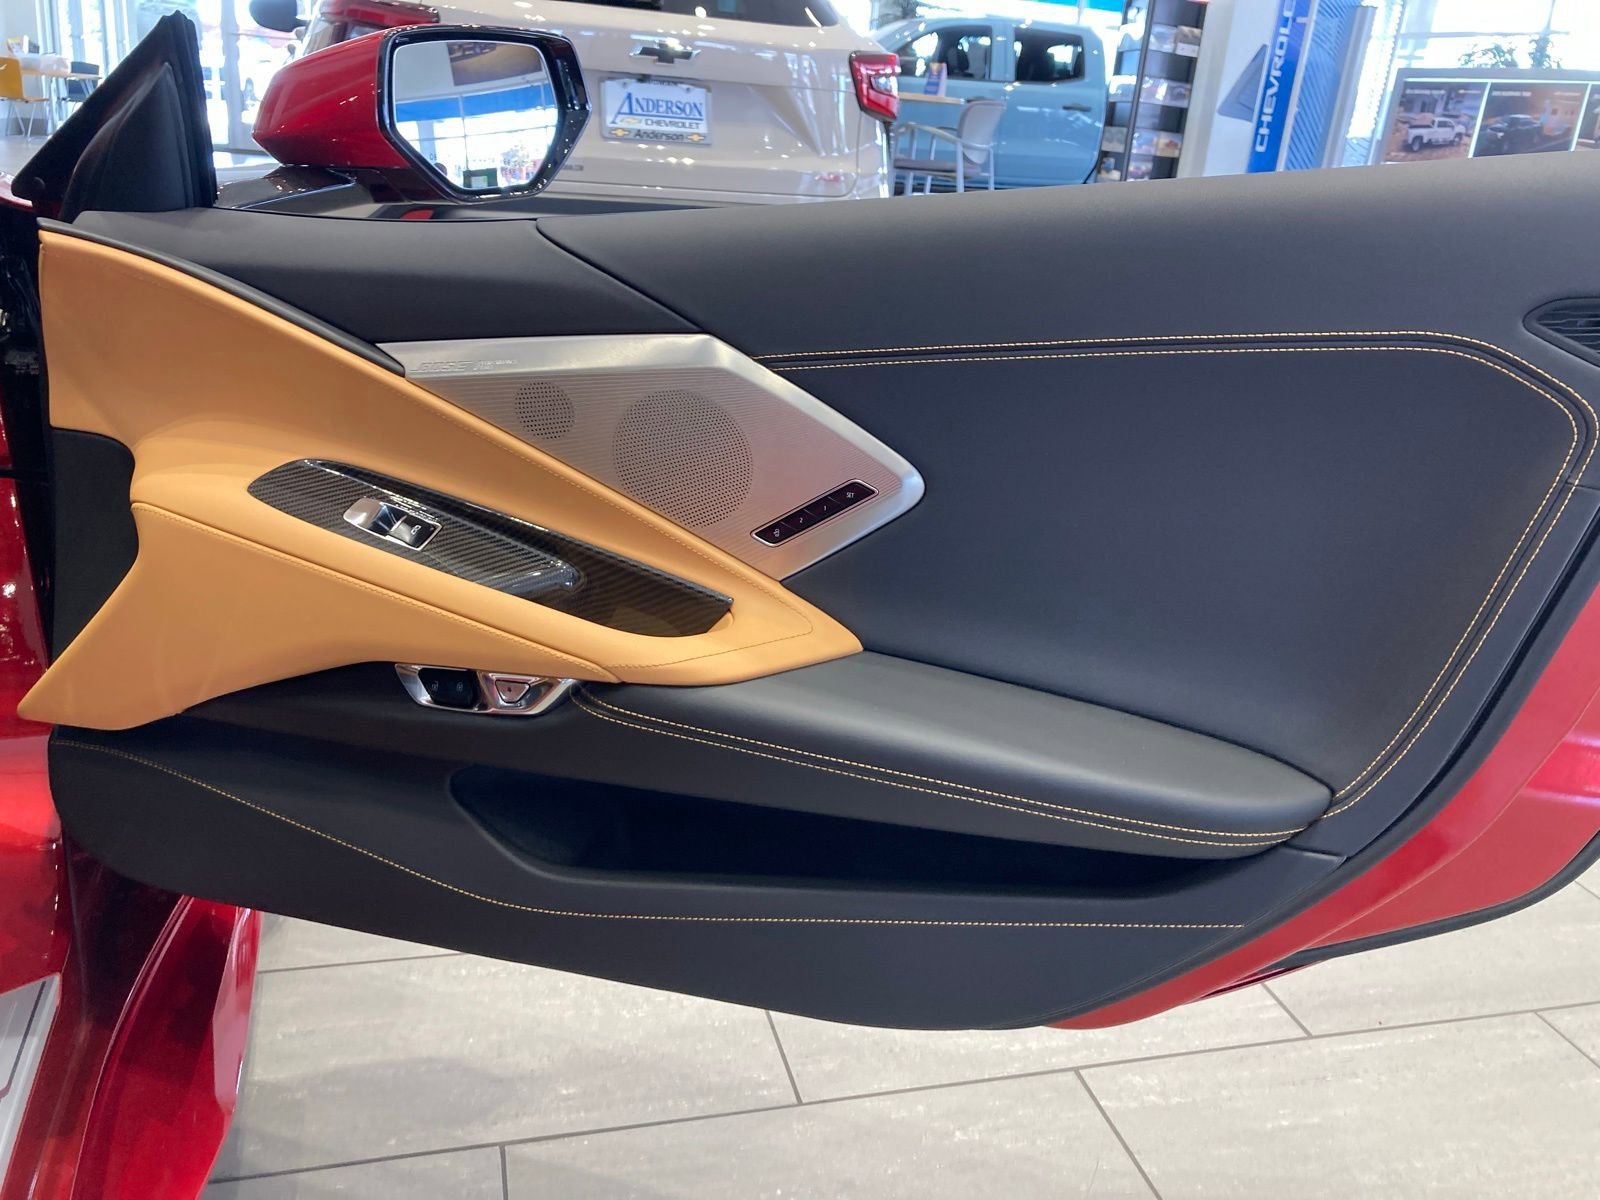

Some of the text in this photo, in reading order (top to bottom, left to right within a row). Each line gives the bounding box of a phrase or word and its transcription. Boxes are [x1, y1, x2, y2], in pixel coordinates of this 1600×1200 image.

[609, 92, 704, 124] ANDERSON
[645, 119, 700, 130] CHEVROLET
[634, 129, 685, 141] Anderson
